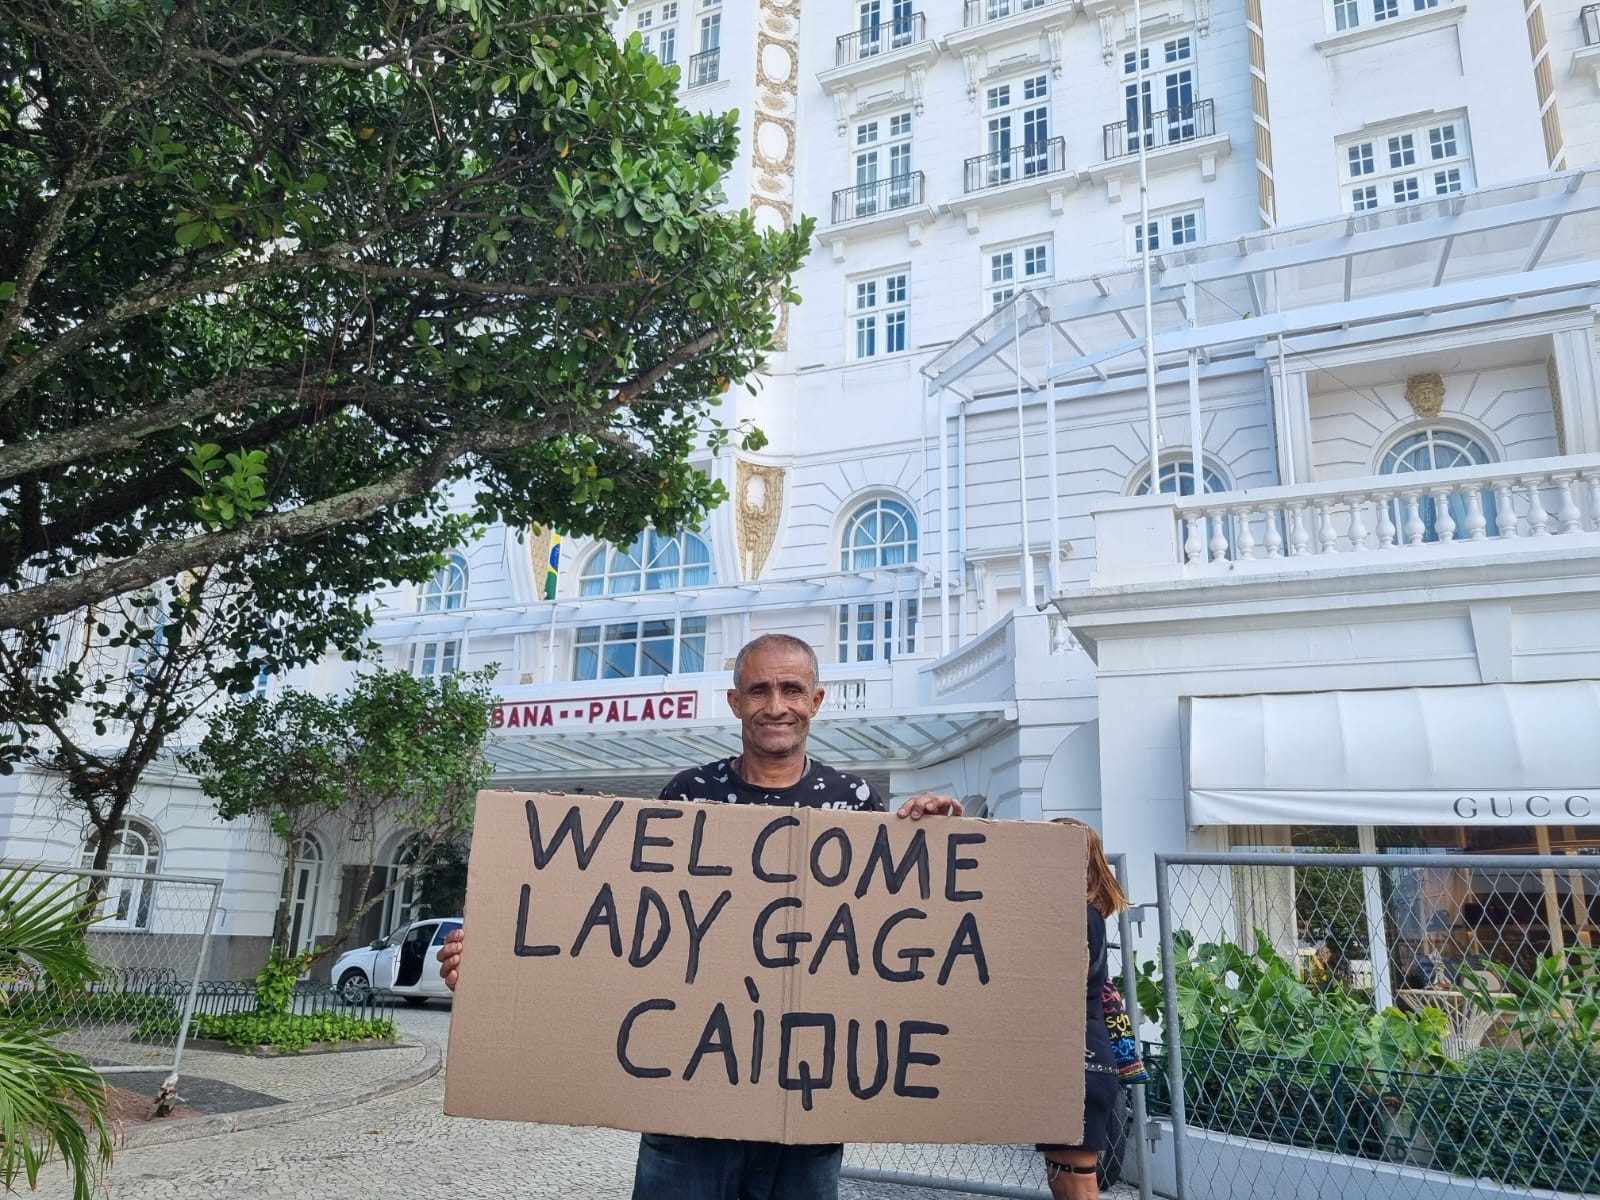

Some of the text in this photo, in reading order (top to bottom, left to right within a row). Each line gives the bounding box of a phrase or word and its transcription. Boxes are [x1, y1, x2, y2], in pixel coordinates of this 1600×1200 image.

[589, 696, 694, 724] PALACE
[525, 800, 987, 902] WELCOME
[513, 883, 990, 986] LADY GAGA
